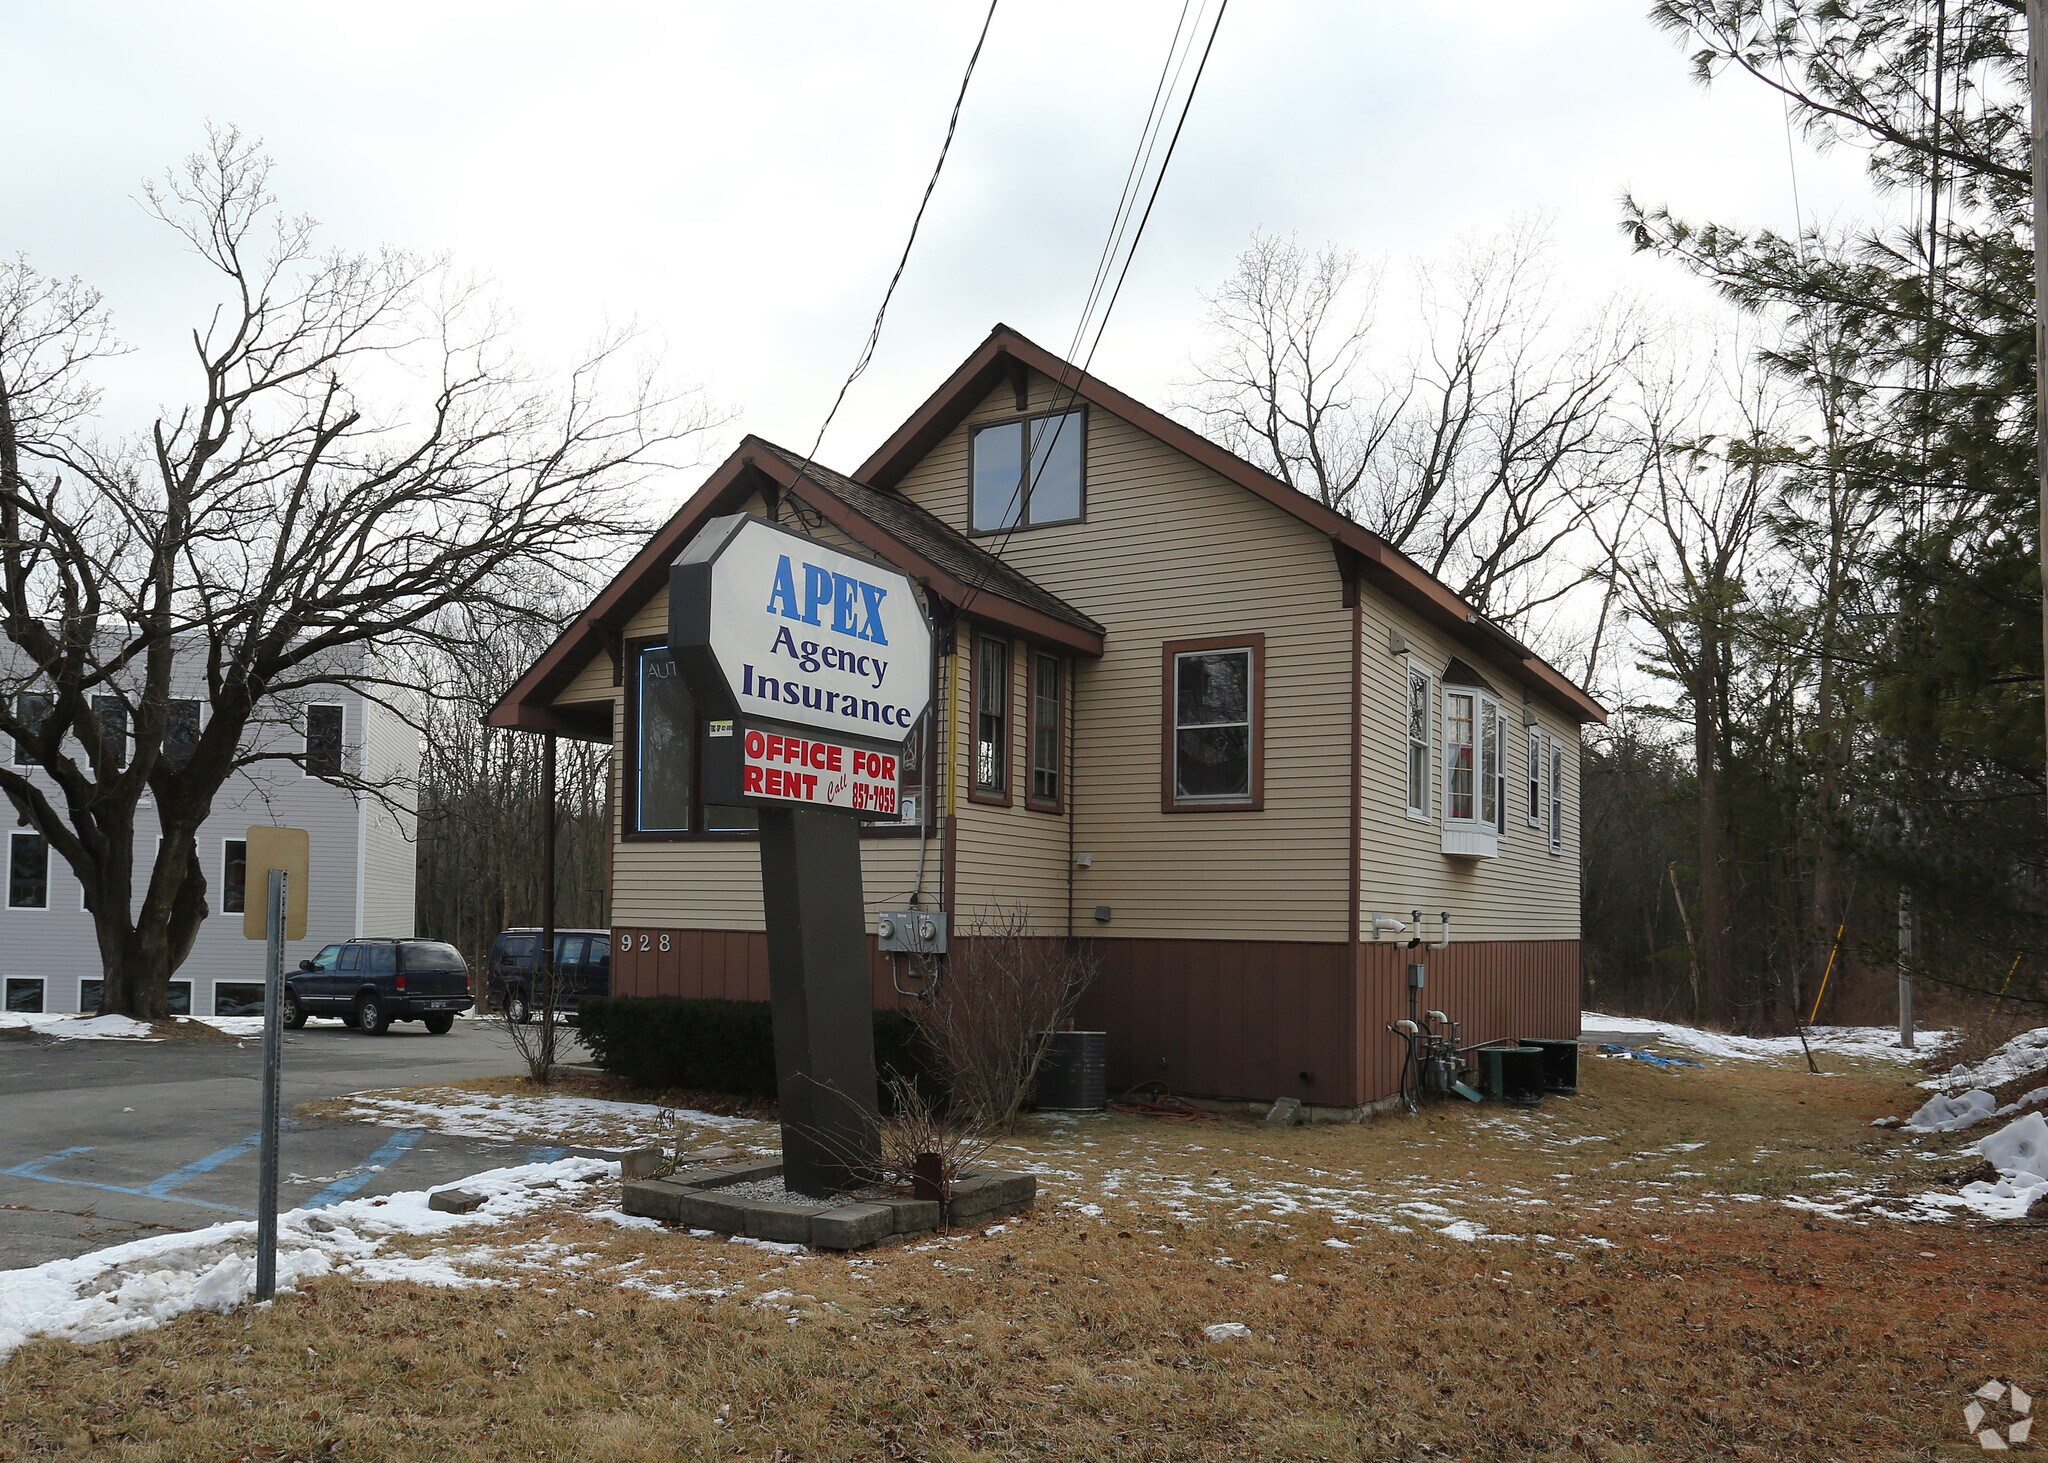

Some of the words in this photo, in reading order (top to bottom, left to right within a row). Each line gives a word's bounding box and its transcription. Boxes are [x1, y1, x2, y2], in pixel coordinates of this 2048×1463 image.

[766, 554, 889, 647] APEX
[770, 625, 889, 689] Agency
[741, 663, 912, 729] Insurance
[744, 730, 843, 773] OFFICE
[852, 749, 896, 781] FOR
[743, 764, 818, 801] RENT
[827, 773, 848, 803] Call
[852, 781, 896, 813] 857-7059
[621, 934, 671, 953] 928
